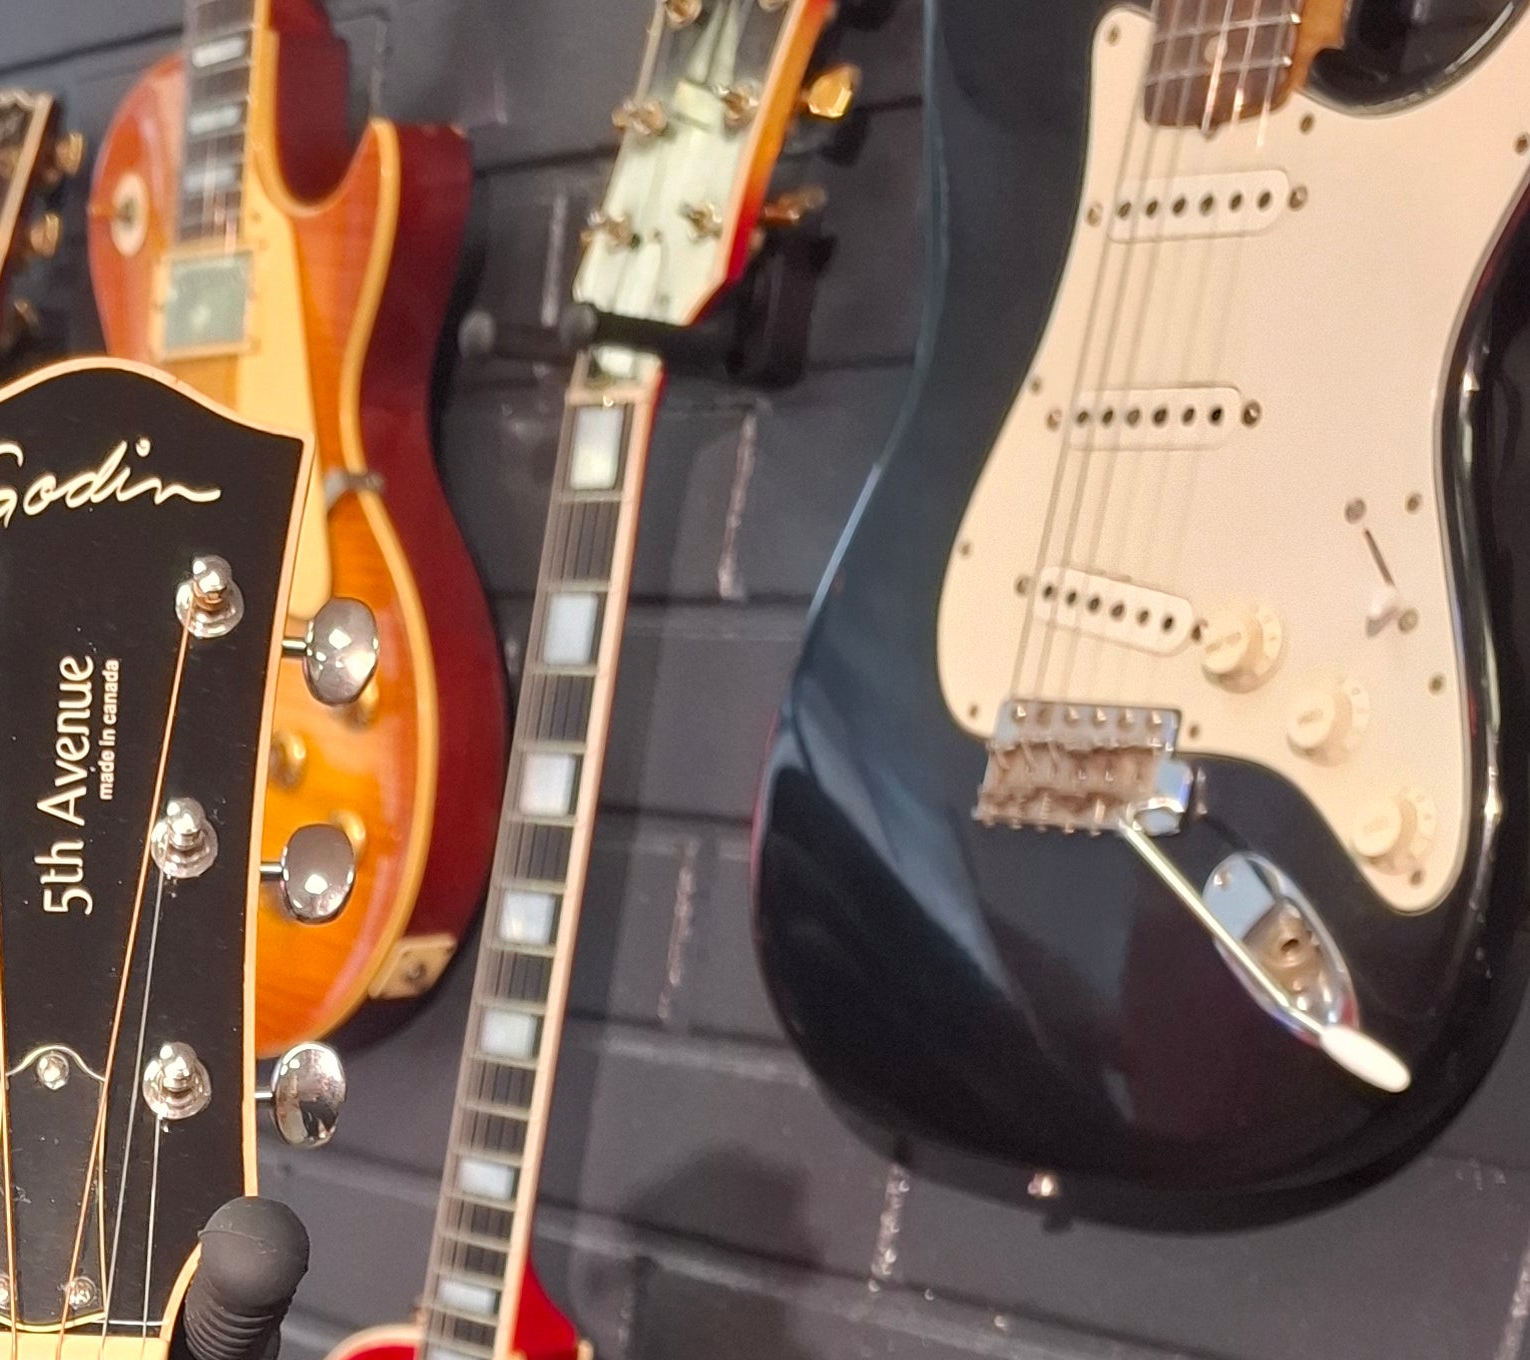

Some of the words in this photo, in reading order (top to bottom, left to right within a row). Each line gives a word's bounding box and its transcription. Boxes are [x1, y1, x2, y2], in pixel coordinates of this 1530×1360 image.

[101, 657, 121, 727] canada
[35, 654, 95, 827] Avenue
[98, 728, 117, 748] in
[97, 749, 115, 801] made
[33, 839, 94, 916] 5th
